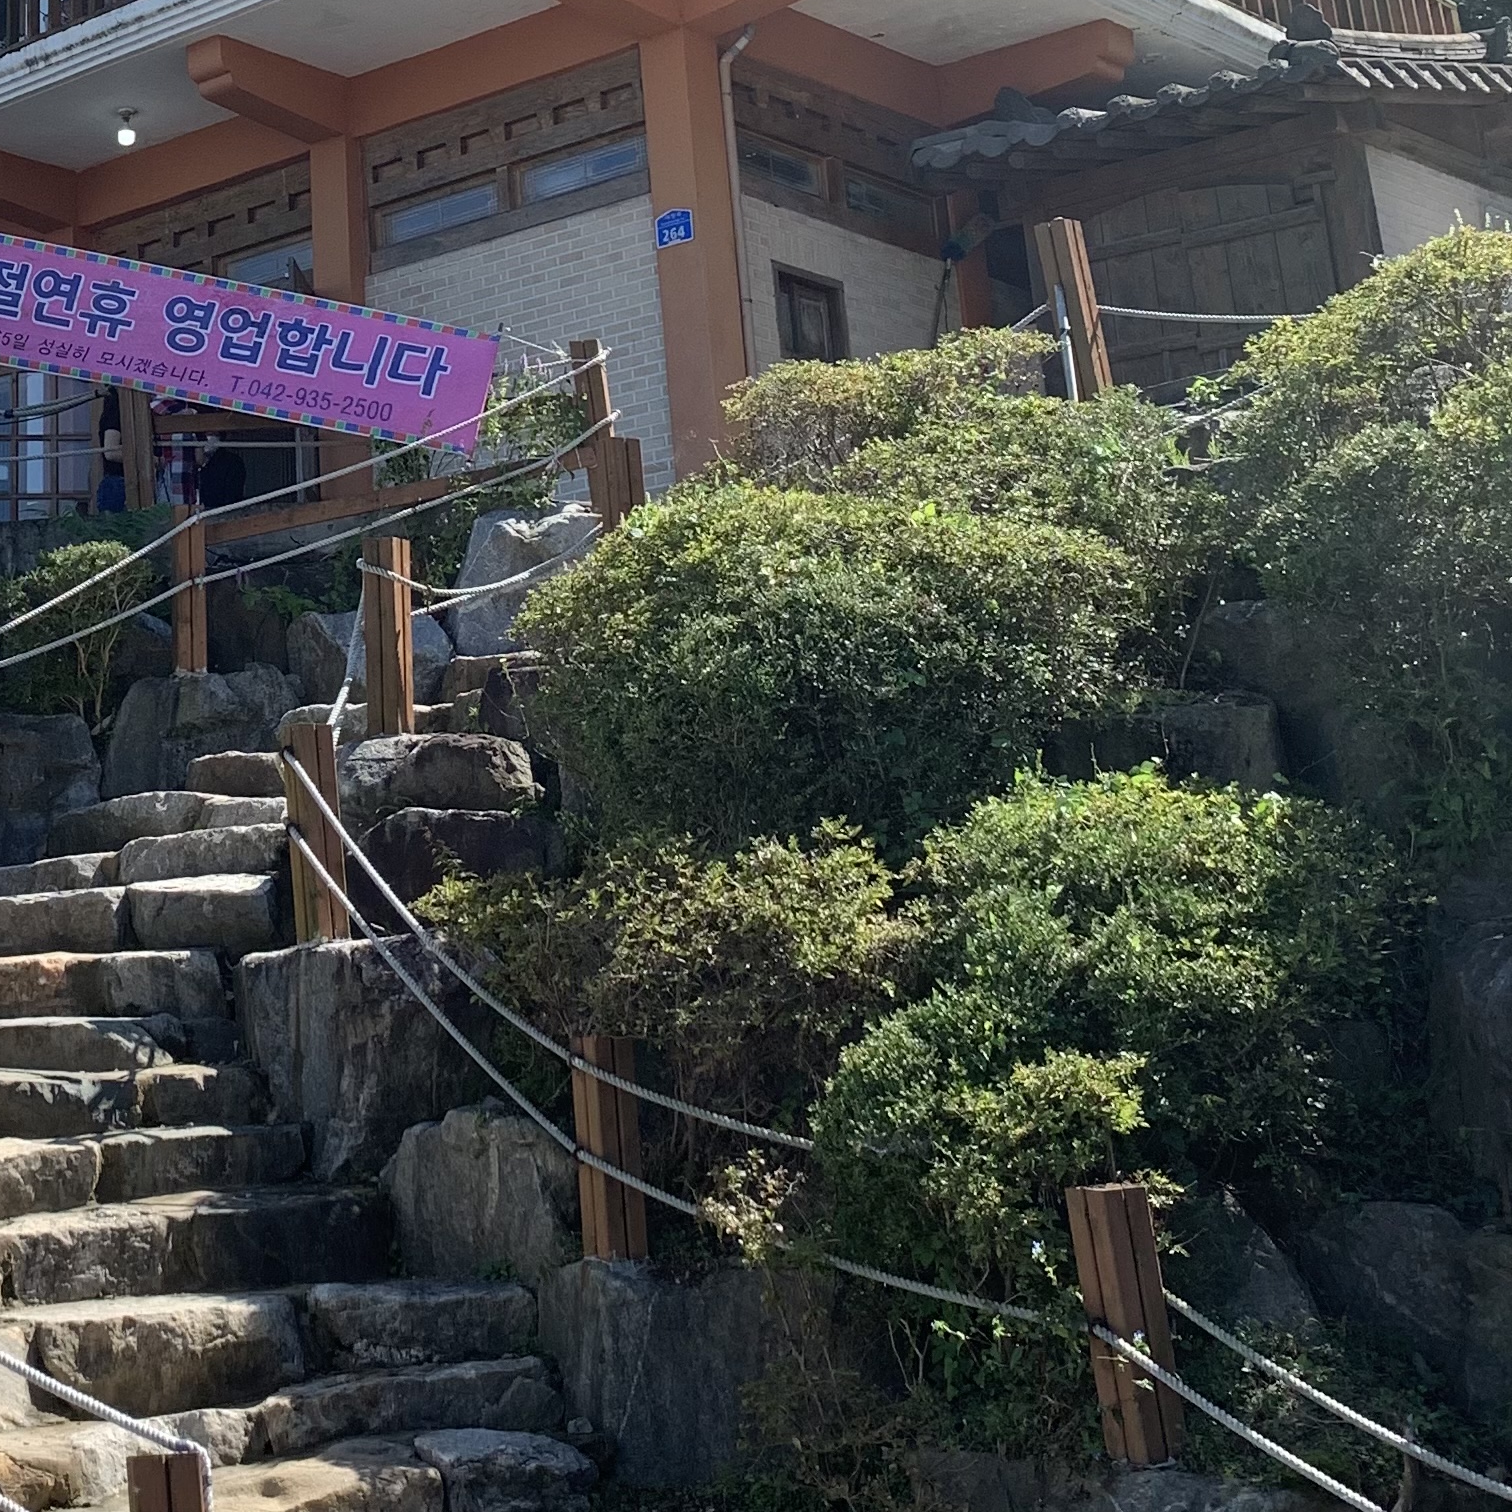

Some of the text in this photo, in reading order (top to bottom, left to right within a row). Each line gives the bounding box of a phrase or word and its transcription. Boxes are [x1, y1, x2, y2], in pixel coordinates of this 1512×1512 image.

[662, 225, 685, 242] 264
[37, 338, 91, 363] 성실히
[230, 374, 394, 423] T.042-935-2500
[163, 294, 451, 399] 영업합니다
